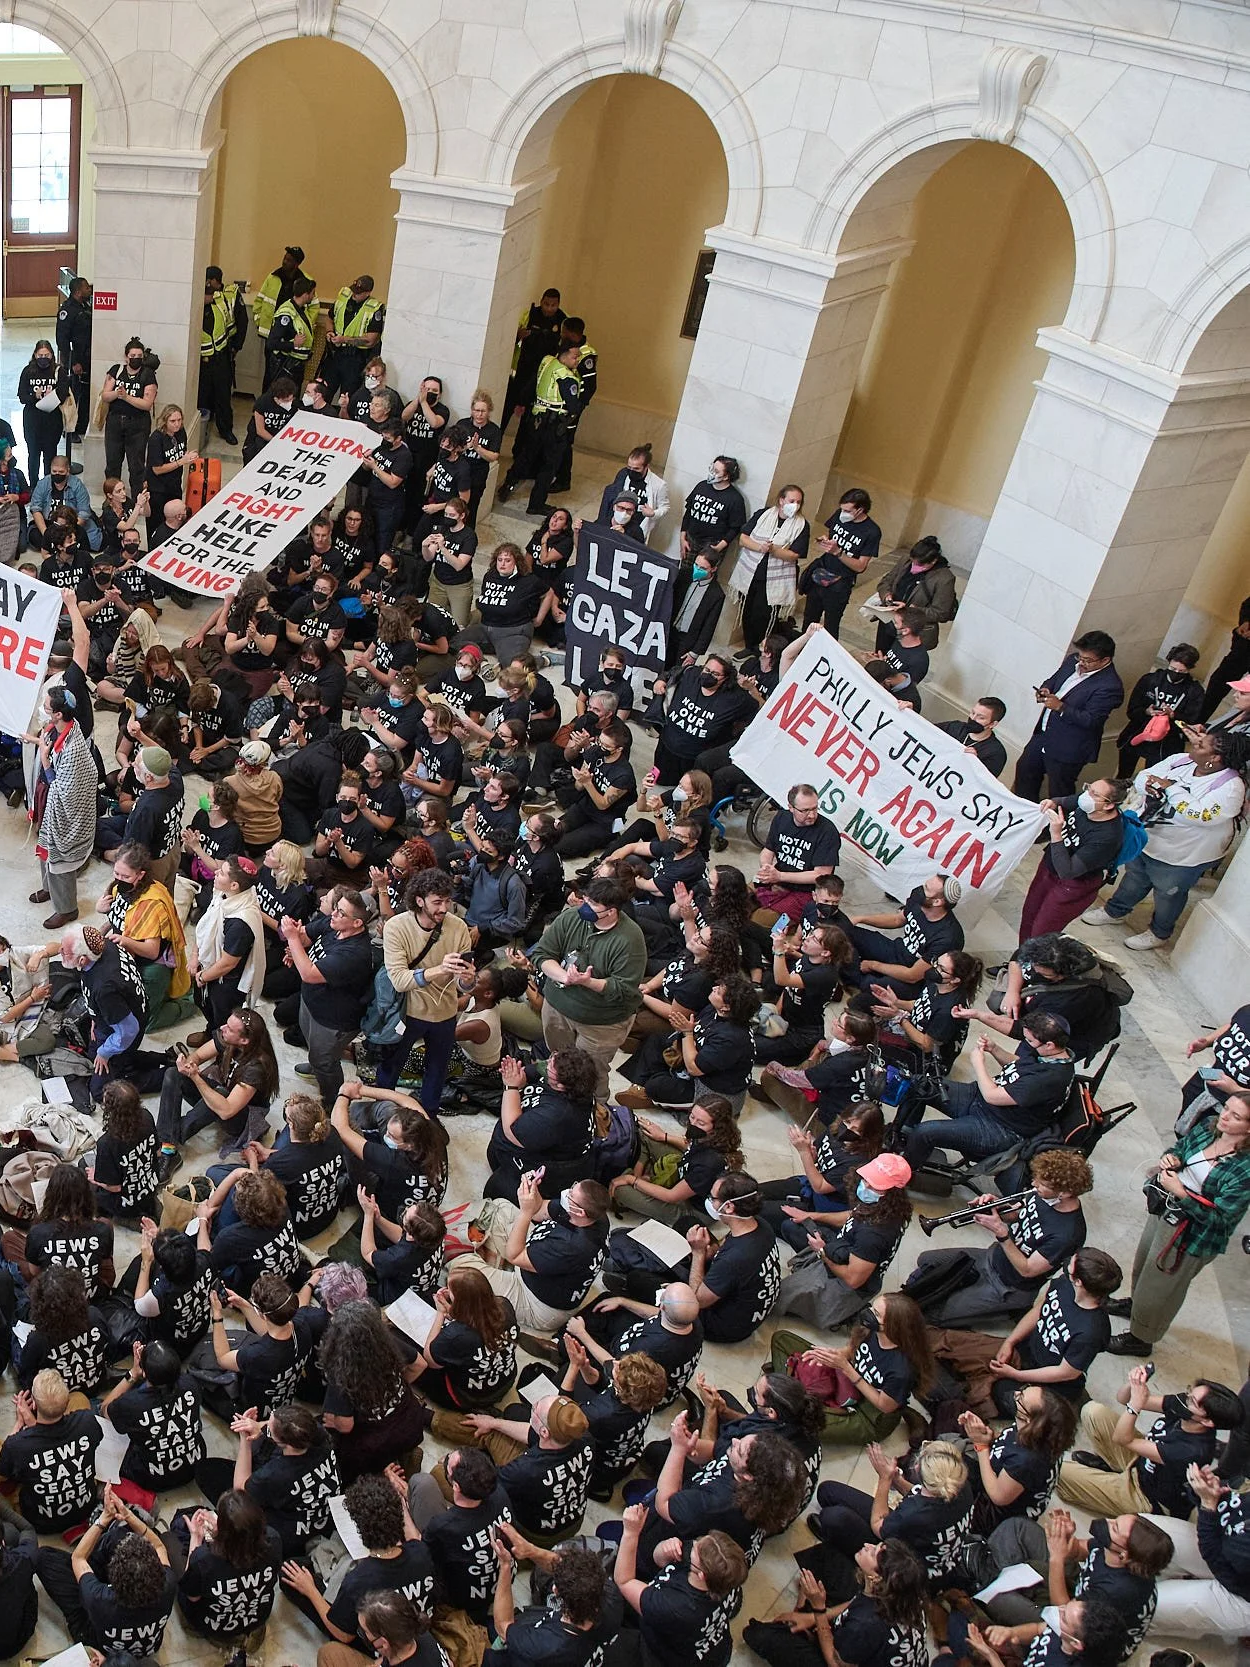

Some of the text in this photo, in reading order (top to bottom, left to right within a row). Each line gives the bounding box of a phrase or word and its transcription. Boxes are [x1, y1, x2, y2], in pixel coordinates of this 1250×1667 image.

[96, 296, 116, 306] EXIT
[280, 427, 373, 459] MOURN
[292, 448, 335, 467] THE
[257, 461, 327, 488] DEAD,
[255, 482, 302, 500] AND
[223, 493, 305, 522] FIGHT
[713, 500, 725, 511] IN
[214, 510, 276, 539] LIKE
[192, 524, 258, 556] HELL
[850, 534, 862, 545] IN
[163, 537, 255, 575] FOR THE
[52, 571, 70, 579] NOT
[56, 576, 80, 585] OUR
[146, 551, 235, 592] LIVING
[586, 542, 670, 611] LET
[484, 589, 506, 598] OUR
[486, 582, 502, 590] NOT
[572, 593, 666, 662] GAZA
[459, 691, 472, 701] IN
[682, 697, 715, 720] NOT IN
[669, 710, 708, 738] NAME
[679, 709, 705, 726] OUR
[805, 656, 1023, 841] PHILLY JEWS SAY
[767, 683, 1002, 889] NEVER AGAIN
[817, 778, 904, 866] IS NOW
[778, 834, 811, 850] NOT IN
[256, 883, 285, 913] NOT IN
[120, 1134, 155, 1167] JEWS
[127, 1149, 153, 1175] SAY
[299, 1154, 343, 1184] JEWS
[306, 1170, 339, 1193] SAY
[296, 1198, 339, 1223] NOW
[44, 1236, 100, 1255] JEWS
[253, 1219, 294, 1260] JEWS
[51, 1253, 93, 1266] SAY
[173, 1268, 213, 1311] JEWS
[1048, 1289, 1063, 1318] NOT
[48, 1326, 101, 1360] JEWS
[56, 1344, 96, 1370] SAY
[150, 1410, 193, 1437] SAY
[28, 1435, 90, 1470] JEWS
[149, 1449, 201, 1476] NOW
[156, 1436, 197, 1462] FIRE
[40, 1455, 86, 1484] SAY
[290, 1450, 337, 1497] JEWS
[542, 1445, 593, 1486] JEWS
[33, 1464, 92, 1495] CEASE
[301, 1471, 340, 1504] SAY
[553, 1465, 590, 1498] SAY
[38, 1492, 92, 1519] NOW
[45, 1485, 88, 1506] FIRE
[211, 1566, 274, 1596] JEWS
[218, 1587, 264, 1606] SAY
[104, 1614, 169, 1641] JEWS
